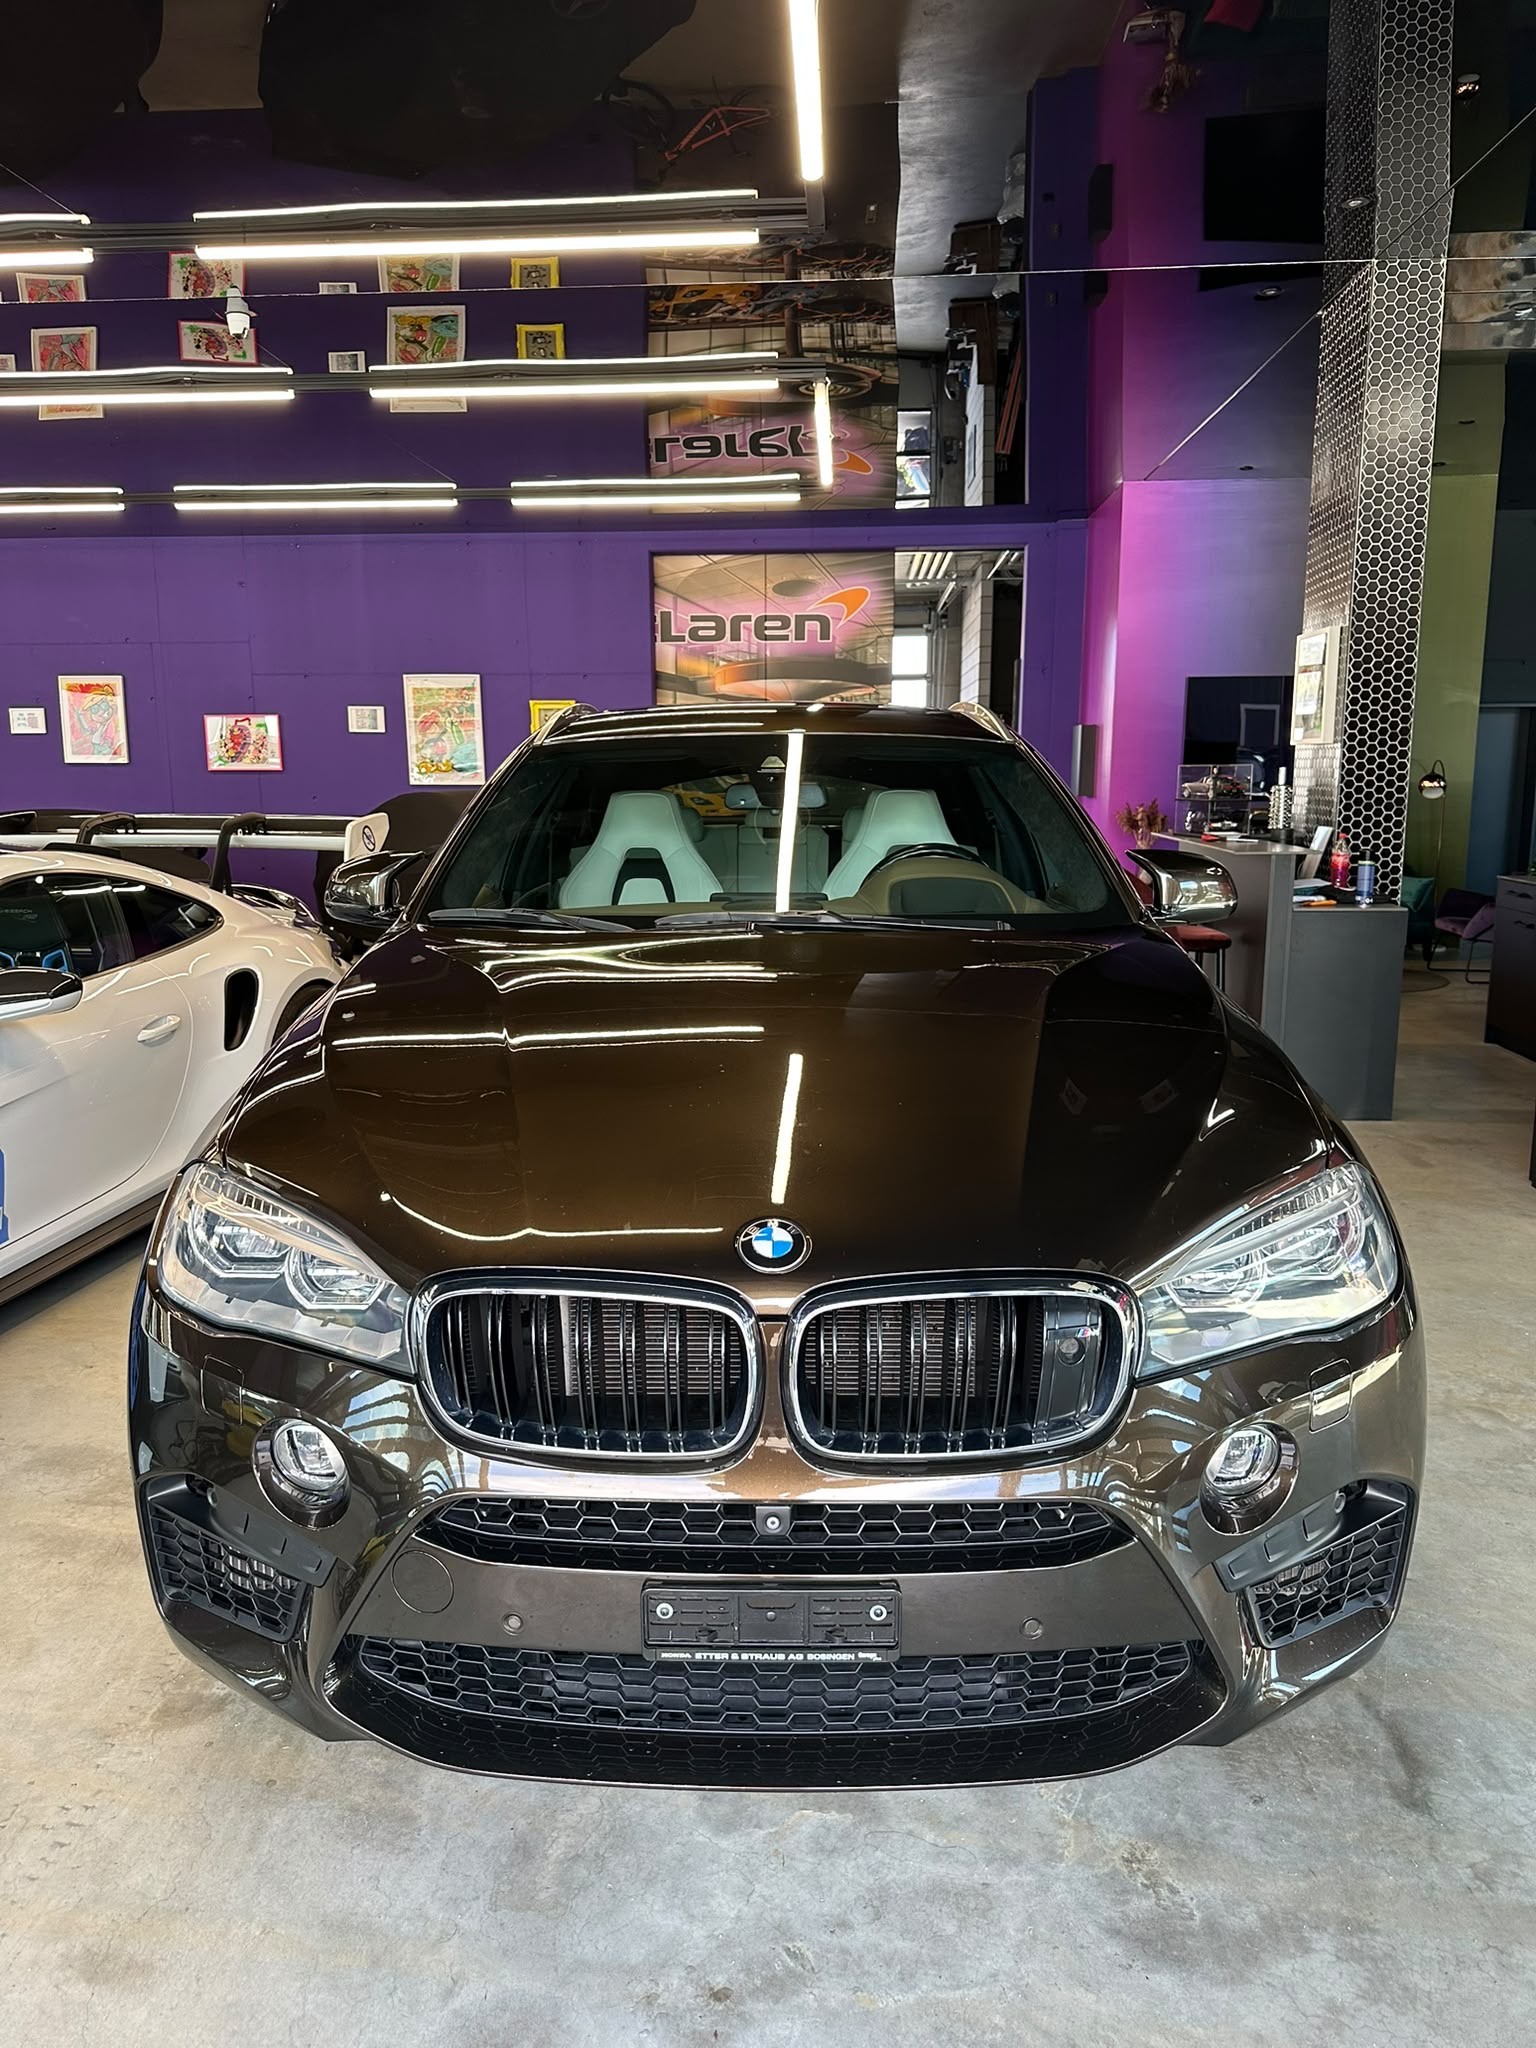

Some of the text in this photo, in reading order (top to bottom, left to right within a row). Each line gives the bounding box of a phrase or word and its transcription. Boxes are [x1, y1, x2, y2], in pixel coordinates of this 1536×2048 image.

[655, 610, 832, 643] Laren
[694, 1652, 729, 1660] ETTER
[730, 1652, 740, 1660] &
